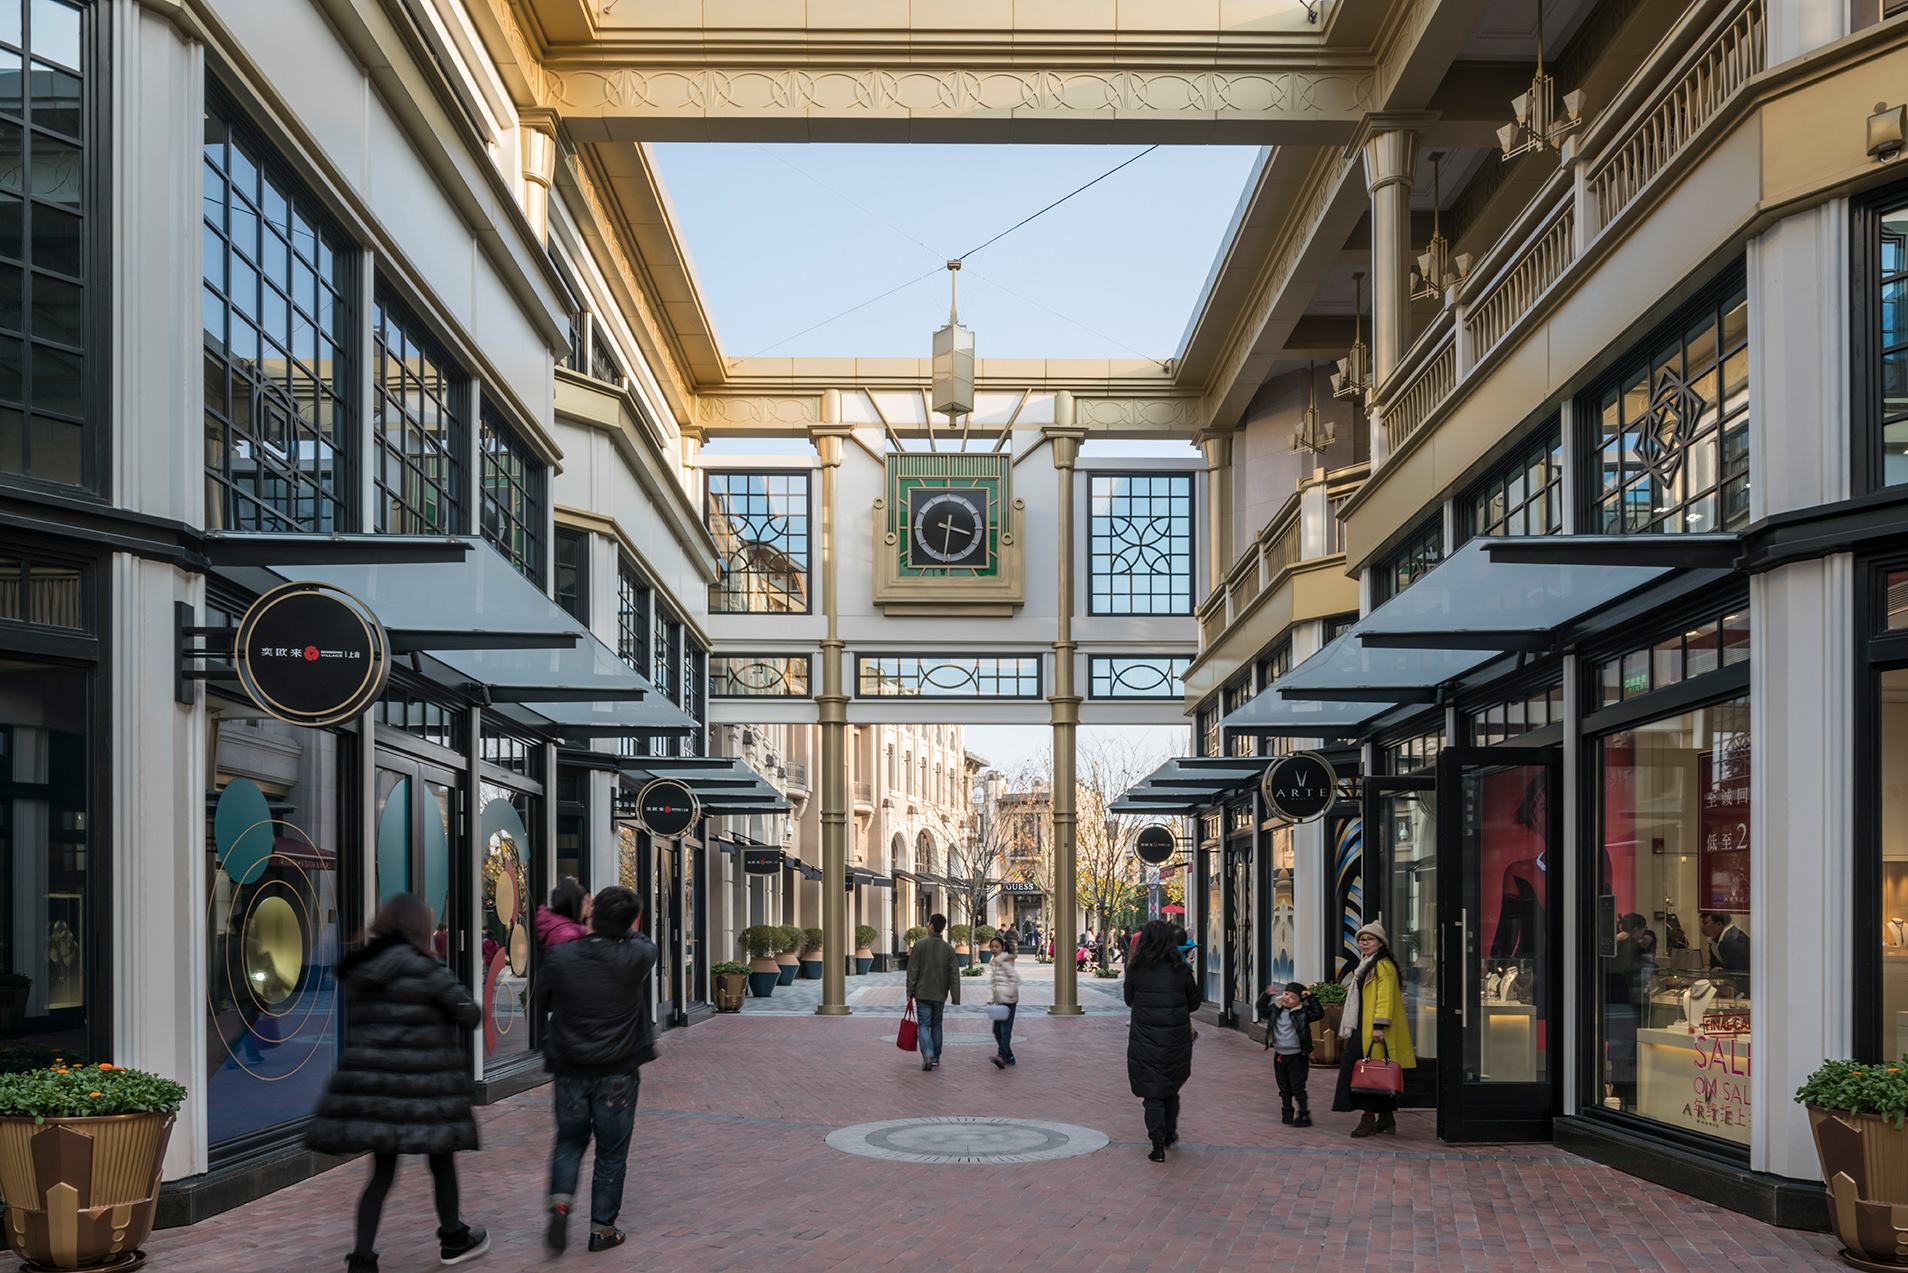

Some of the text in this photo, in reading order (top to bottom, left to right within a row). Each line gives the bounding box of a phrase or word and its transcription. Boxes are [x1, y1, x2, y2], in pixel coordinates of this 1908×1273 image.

[261, 647, 302, 658] 奕欧来
[1276, 788, 1328, 798] ARTE
[1705, 787, 1748, 808] 至诚回
[1006, 883, 1034, 891] GUESS
[1706, 1019, 1732, 1031] FINAL
[1694, 1076, 1717, 1099] ON
[1693, 1098, 1751, 1129] 年终折上
